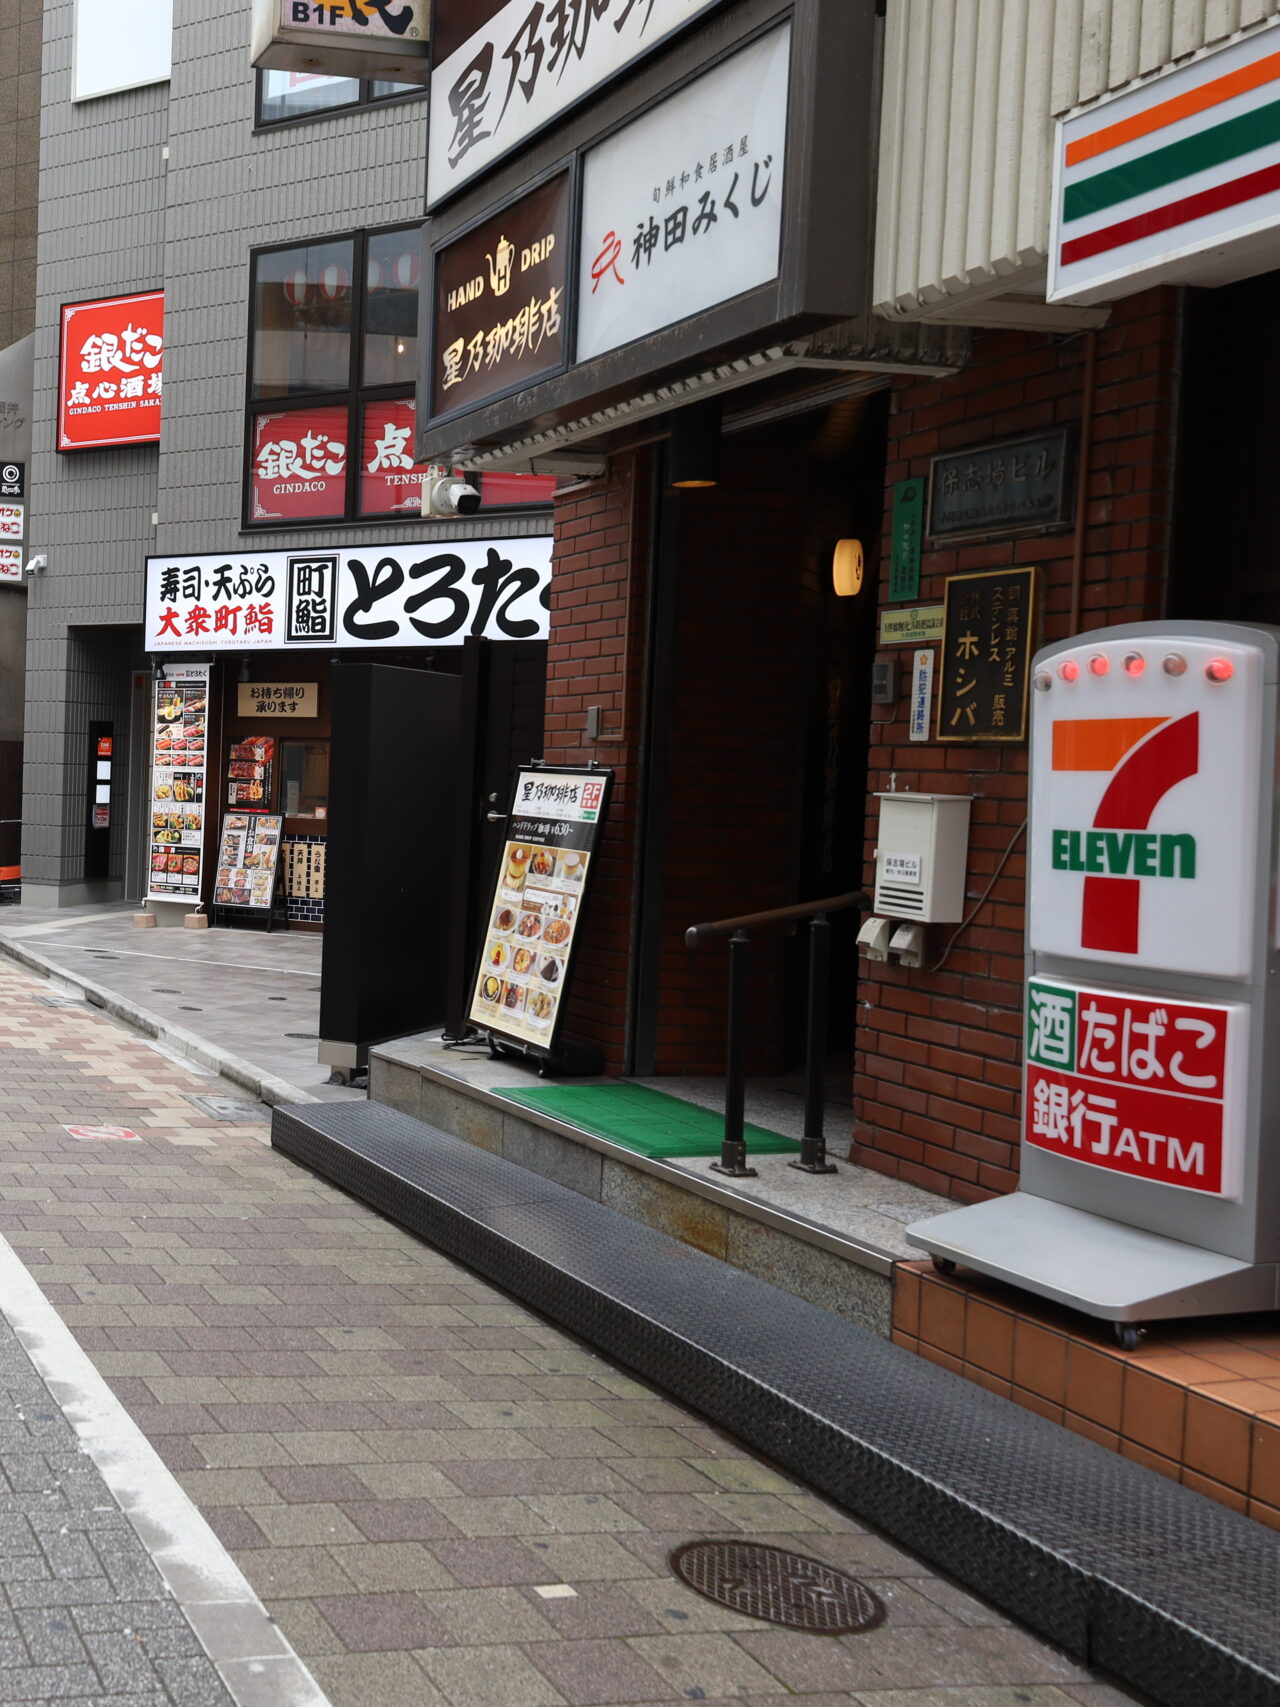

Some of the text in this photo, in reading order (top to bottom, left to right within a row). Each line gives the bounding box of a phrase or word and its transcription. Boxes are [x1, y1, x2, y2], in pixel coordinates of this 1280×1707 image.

[292, 1, 345, 26] B1F
[448, 0, 655, 170] 星乃珈
[652, 134, 749, 204] 旬鮮和食居酒屋
[631, 154, 773, 270] 神田みくじ
[447, 233, 555, 313] HAND DRIP
[80, 322, 164, 373] 銀だこ
[442, 286, 564, 391] 星乃珈琲店
[69, 398, 161, 415] GINDACO TENSHIN SAKA
[257, 429, 346, 479] 銀だこ
[367, 422, 414, 474] 点
[273, 481, 326, 494] GINDACO
[160, 564, 275, 603] 寿司・天ぷら
[295, 563, 329, 634] 町鮨
[154, 602, 274, 637] 大衆町鮨
[250, 687, 305, 700] お持ち帰り
[950, 630, 982, 727] ホシバ
[255, 700, 299, 714] 承ります
[522, 781, 580, 804] 星乃珈琲店
[583, 784, 602, 800] 2F
[1030, 988, 1218, 1089] 酒 たばこ
[1032, 1078, 1205, 1176] 銀行ATM
